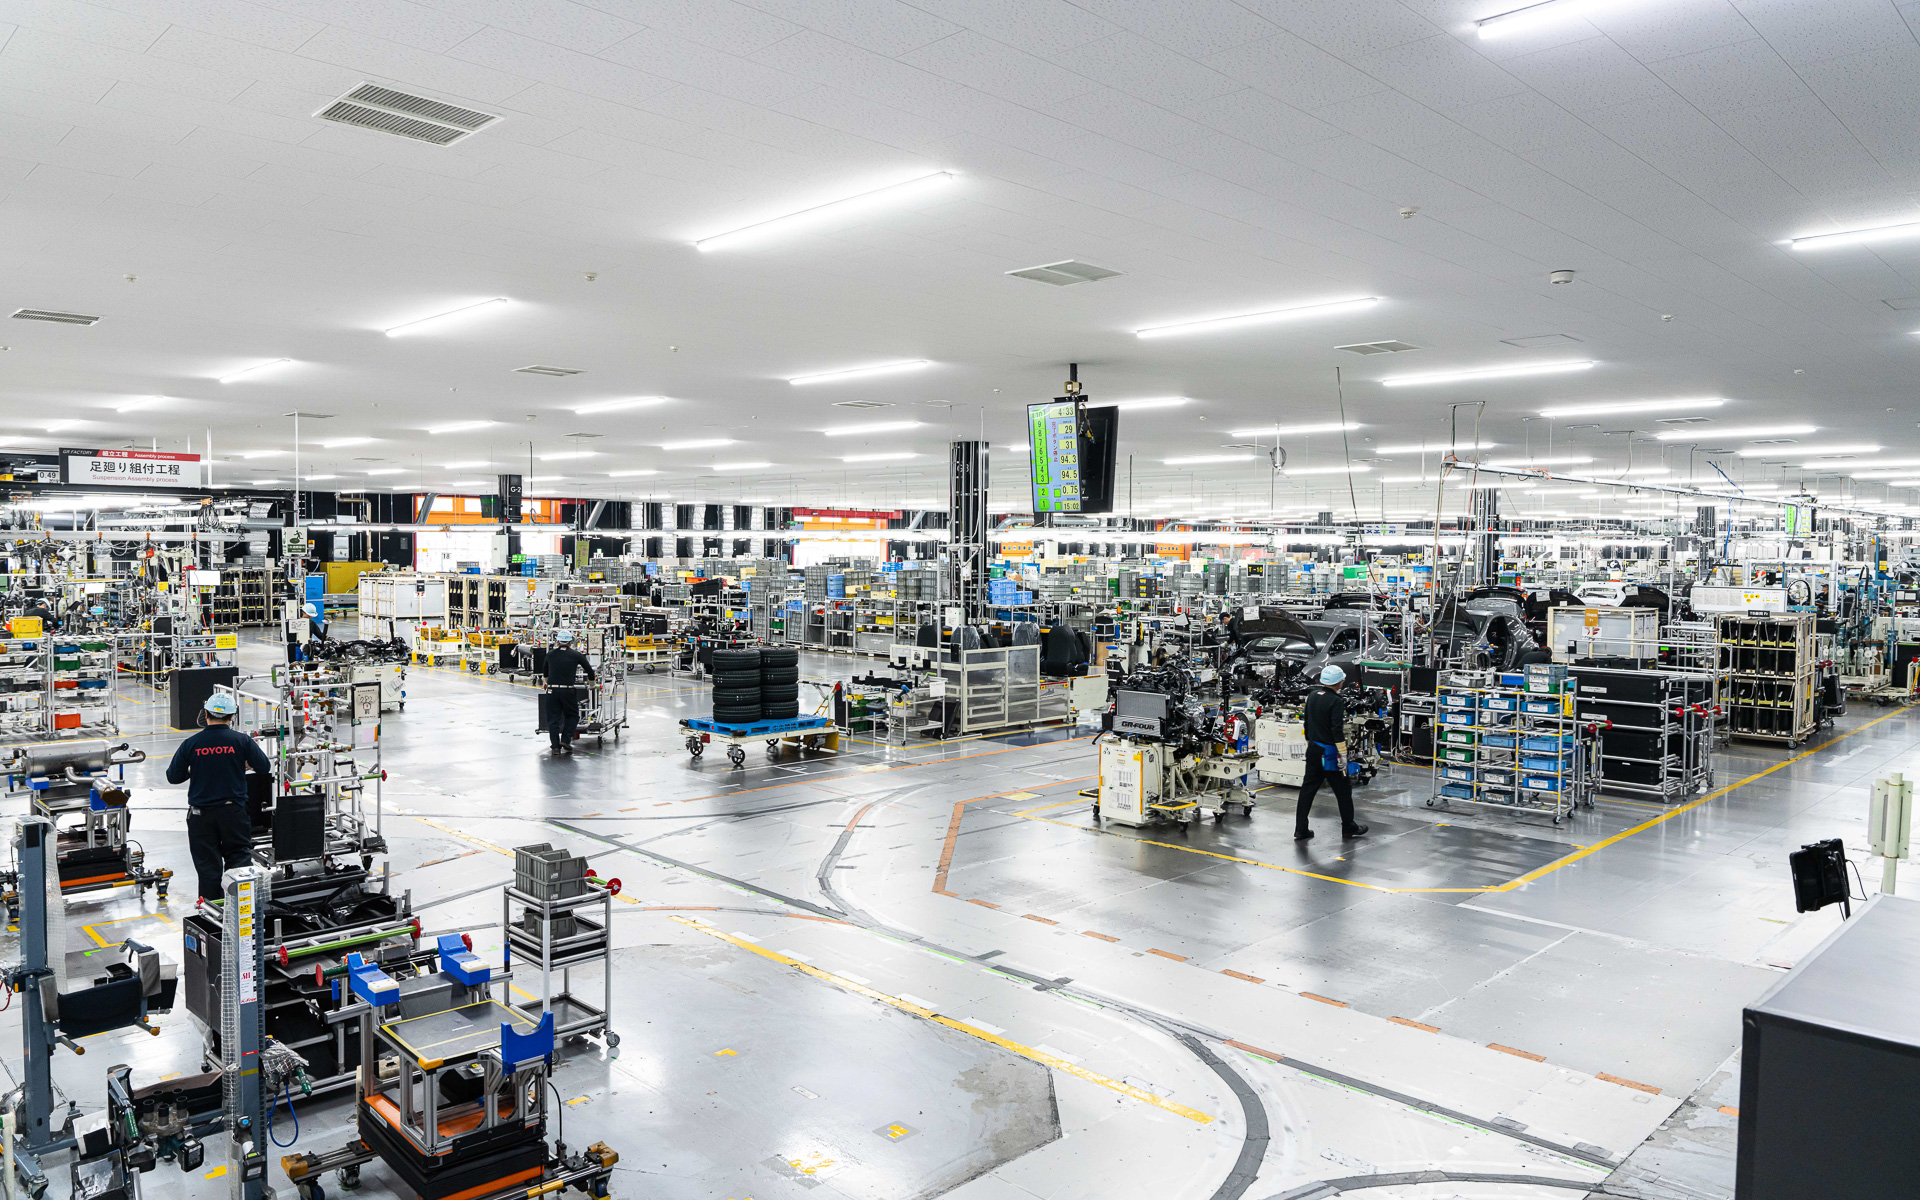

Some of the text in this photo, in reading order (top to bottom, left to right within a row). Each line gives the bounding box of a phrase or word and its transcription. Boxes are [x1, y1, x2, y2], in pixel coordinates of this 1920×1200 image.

[1058, 407, 1074, 416] 4:33
[1064, 425, 1073, 434] 29
[1065, 441, 1073, 449] 31
[102, 450, 129, 458] 組立工程
[134, 452, 157, 460] Assembly
[1060, 454, 1077, 464] 94.3
[90, 460, 181, 476] 足廻り組付工程
[39, 471, 57, 479] 0.49
[92, 474, 127, 482] Suspension
[127, 475, 153, 483] Assembly
[1061, 469, 1078, 479] 94.5
[1062, 485, 1079, 494] 0.75
[1063, 502, 1080, 510] 15:02
[1121, 720, 1155, 731] GR-FOUR
[195, 746, 236, 756] TOYOTA
